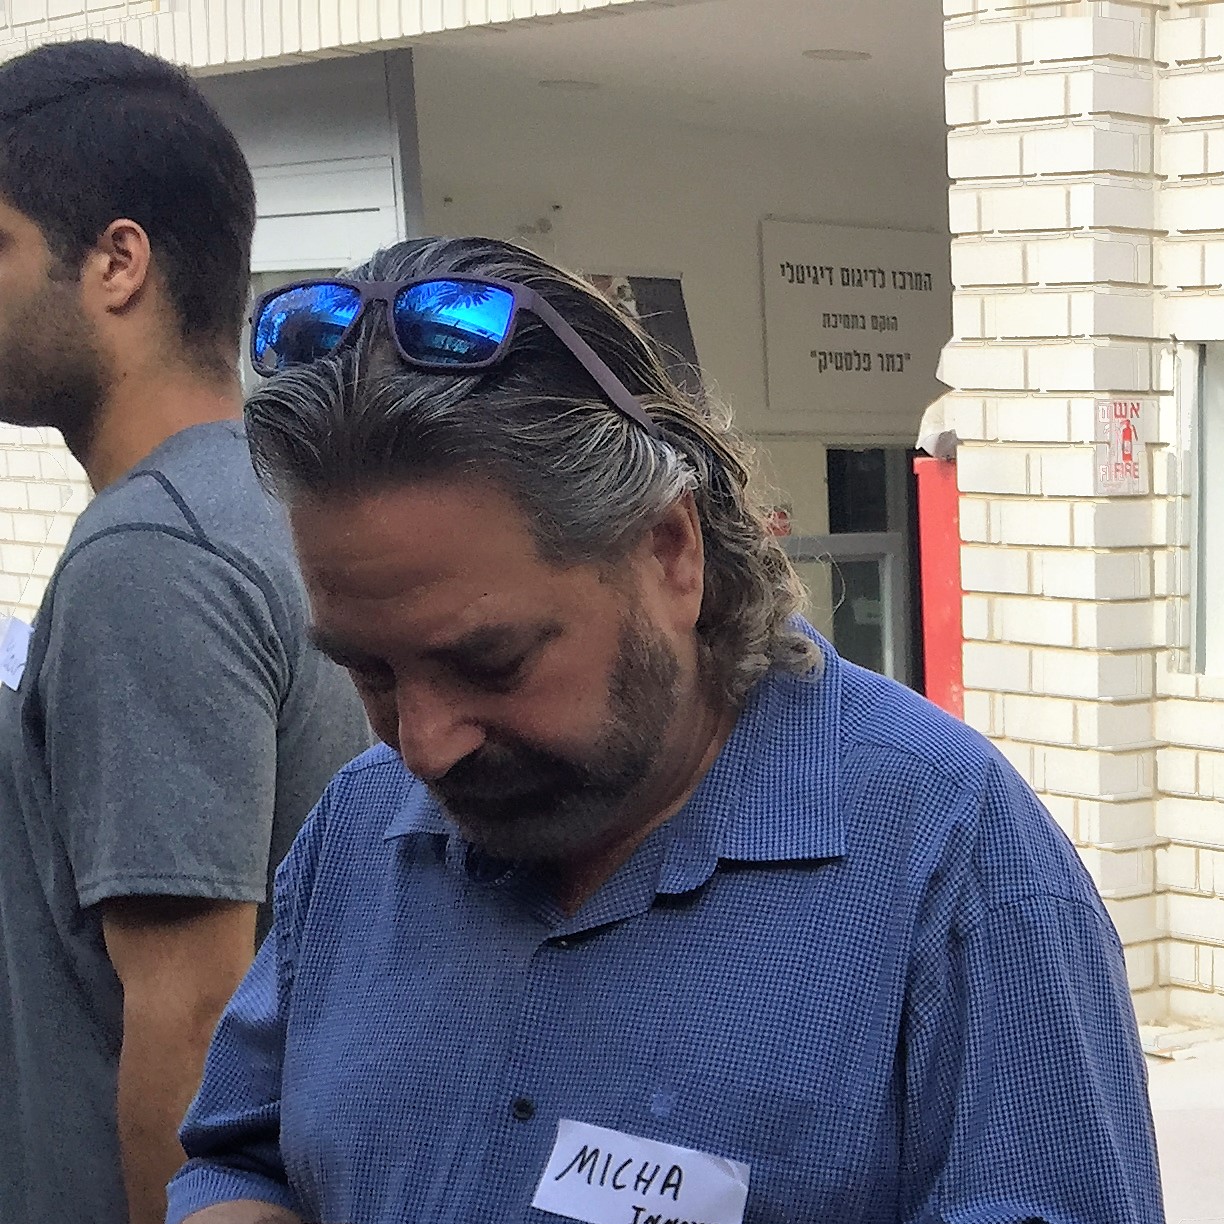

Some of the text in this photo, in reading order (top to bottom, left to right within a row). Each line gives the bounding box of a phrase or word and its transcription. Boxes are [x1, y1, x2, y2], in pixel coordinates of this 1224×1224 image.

[779, 261, 834, 286] דיגיטלי
[891, 270, 933, 291] המרכז
[871, 315, 899, 333] הוקם
[554, 1144, 684, 1202] MICHA
